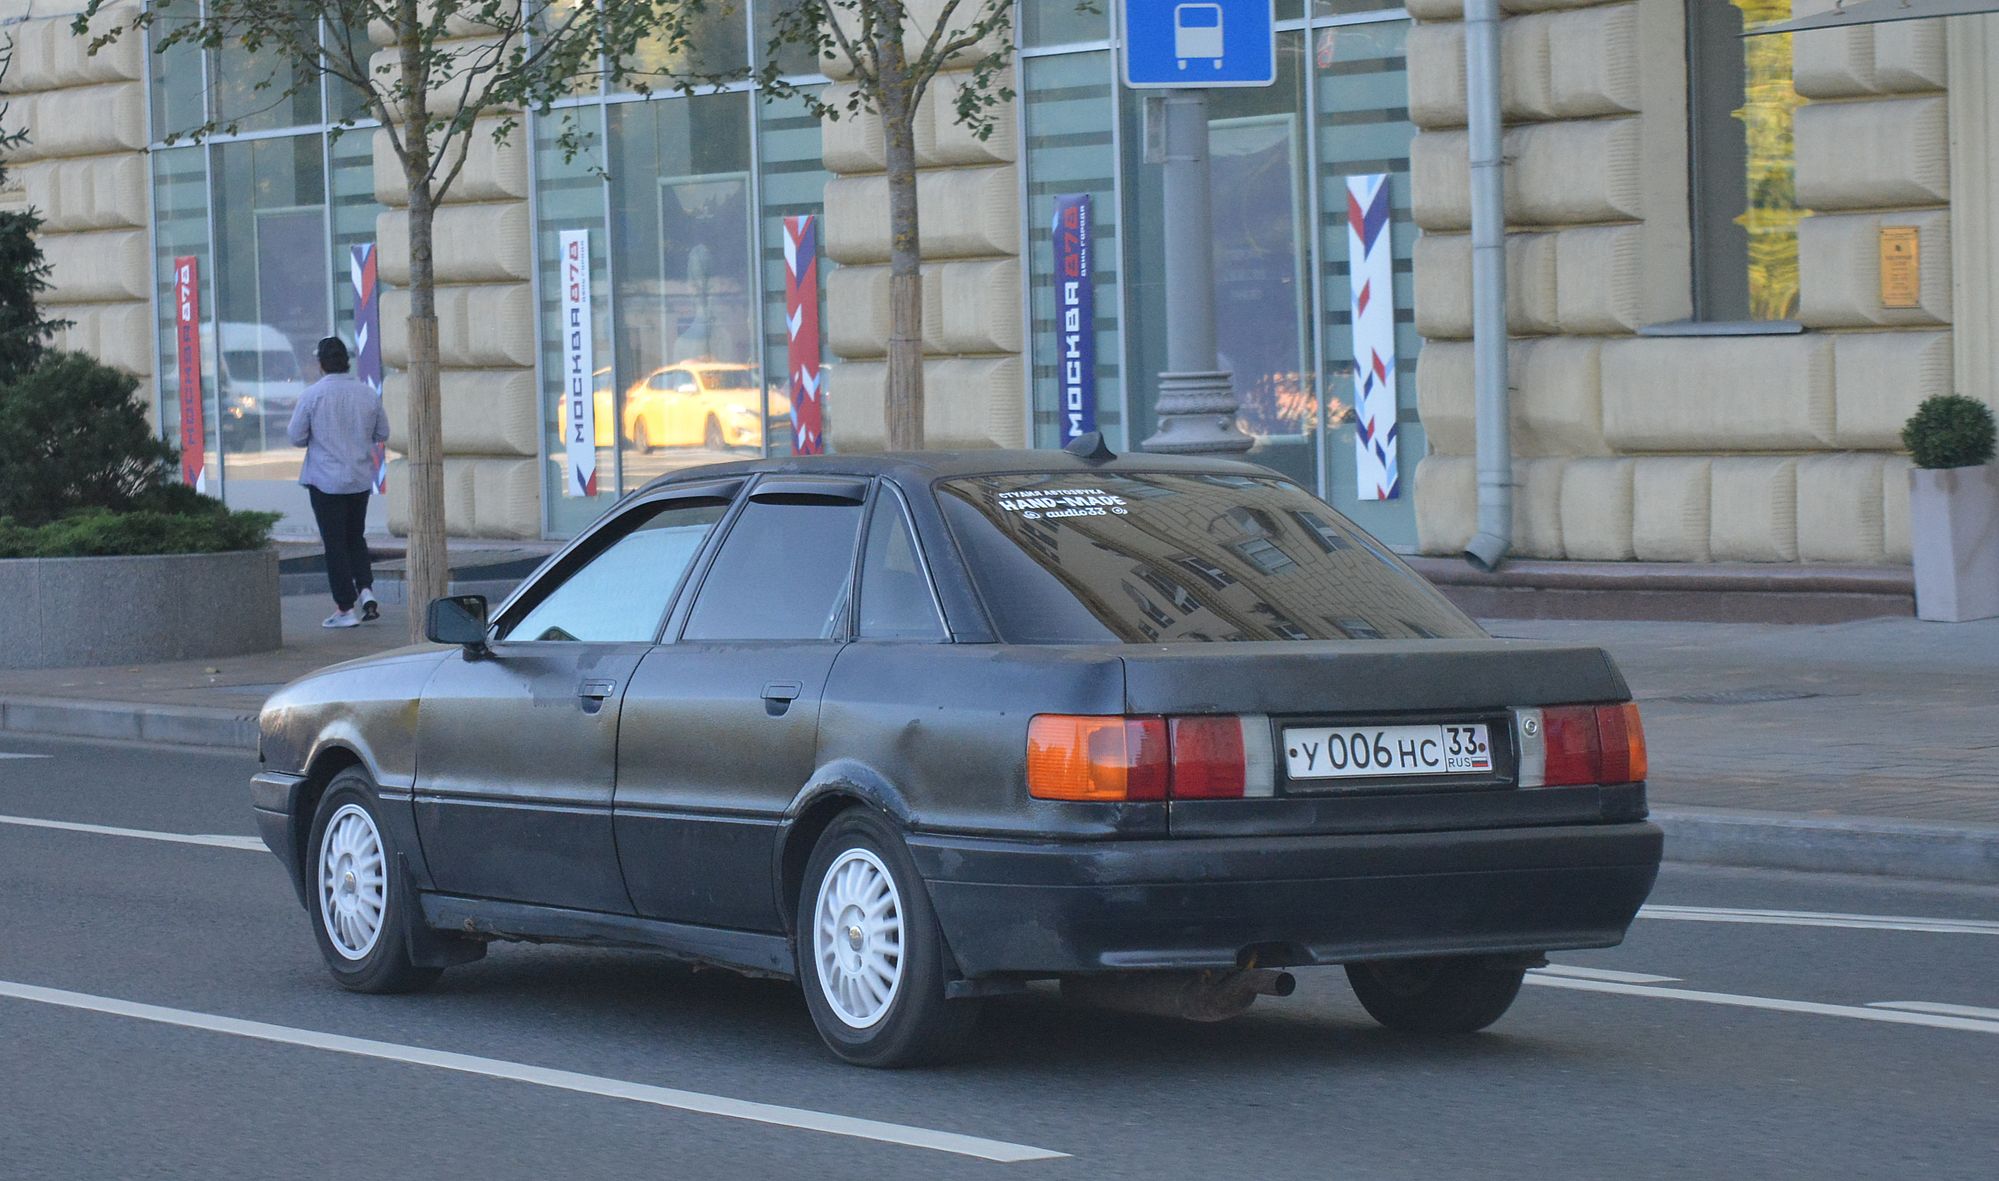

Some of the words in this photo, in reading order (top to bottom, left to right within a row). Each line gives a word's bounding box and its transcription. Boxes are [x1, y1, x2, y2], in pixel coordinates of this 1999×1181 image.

[569, 240, 580, 303] 878
[570, 308, 585, 443] МОСКВА
[1065, 281, 1083, 437] МОСКВА
[183, 324, 195, 445] МОСКВА
[998, 495, 1127, 511] HAND-MADE
[1045, 507, 1107, 518] audio33
[1446, 727, 1477, 756] 33
[1448, 757, 1471, 768] RUS
